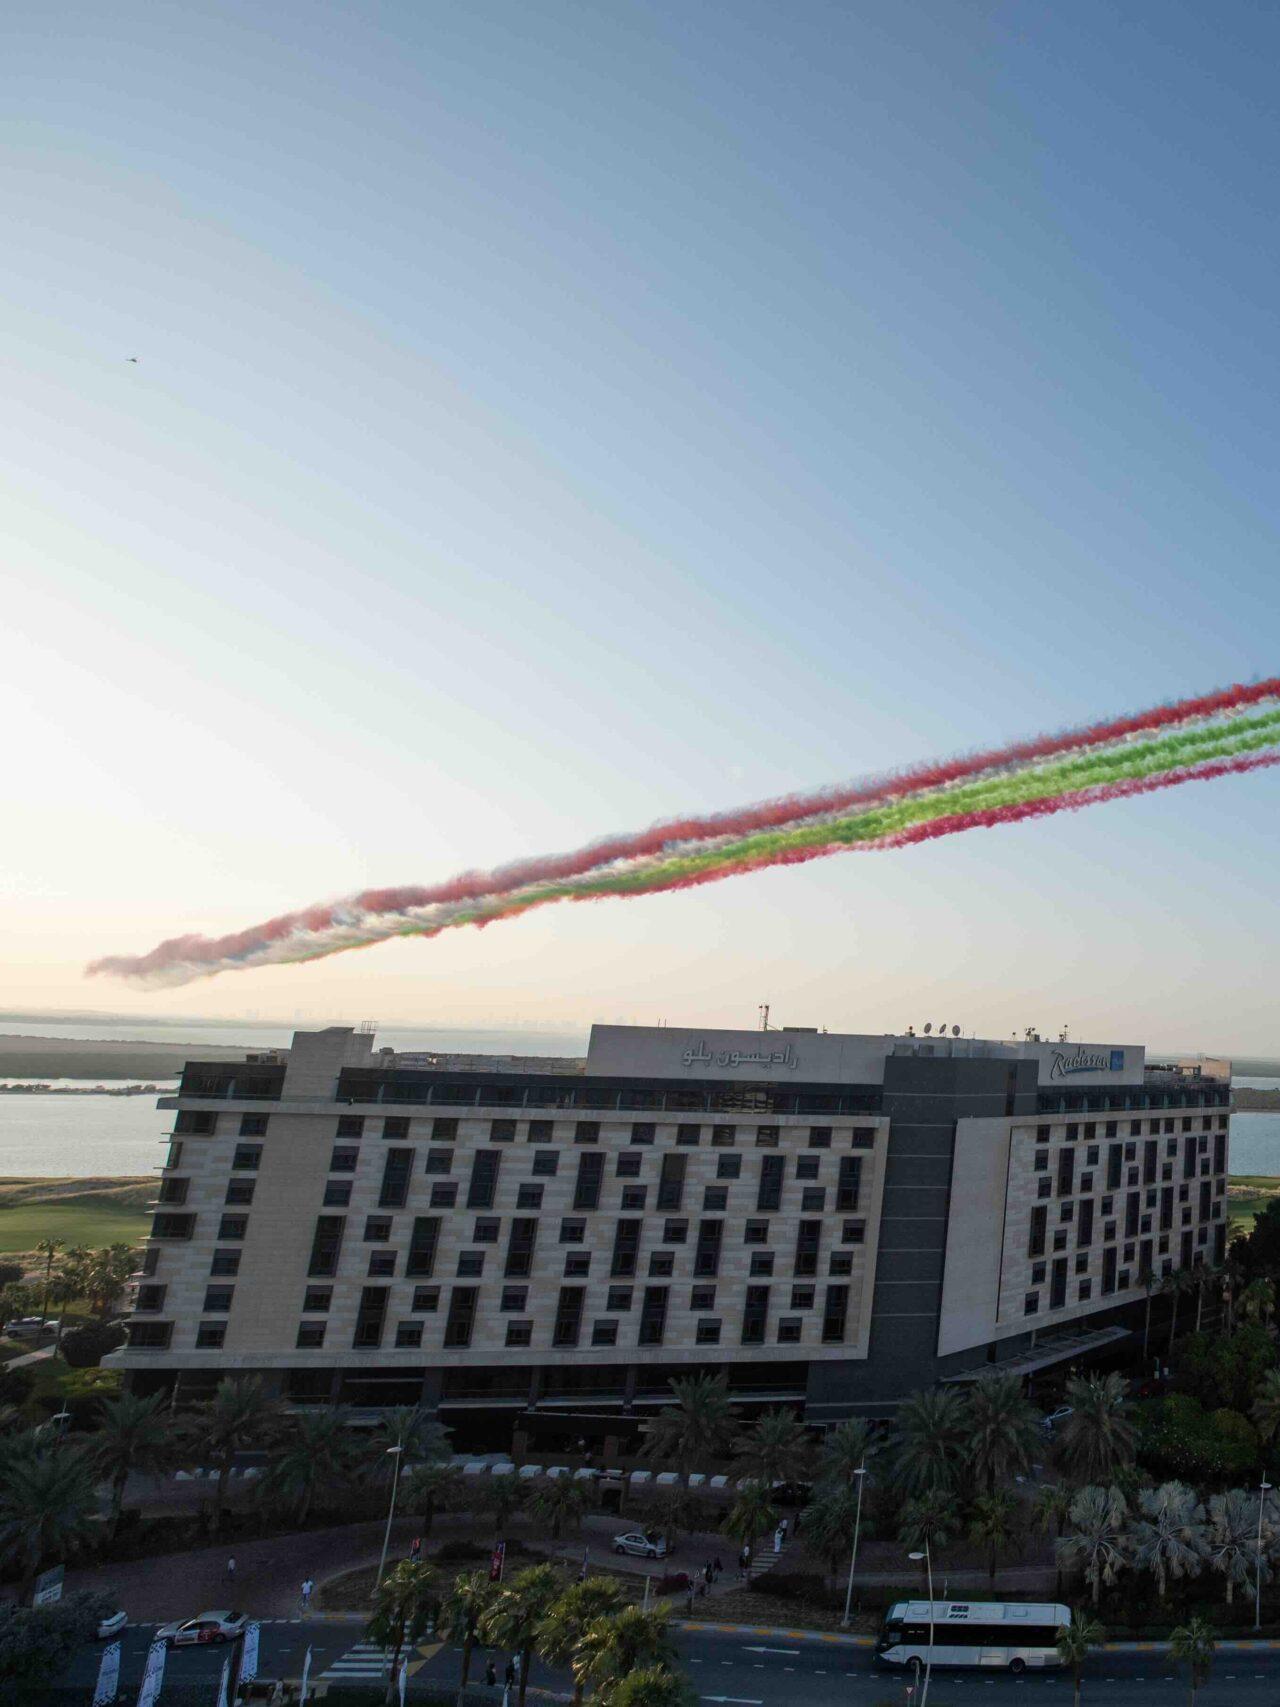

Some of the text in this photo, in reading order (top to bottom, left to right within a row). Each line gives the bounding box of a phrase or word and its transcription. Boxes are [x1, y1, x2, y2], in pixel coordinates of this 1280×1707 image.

[680, 1039, 799, 1069] راديسون بلو
[1050, 1046, 1108, 1080] Radisson
